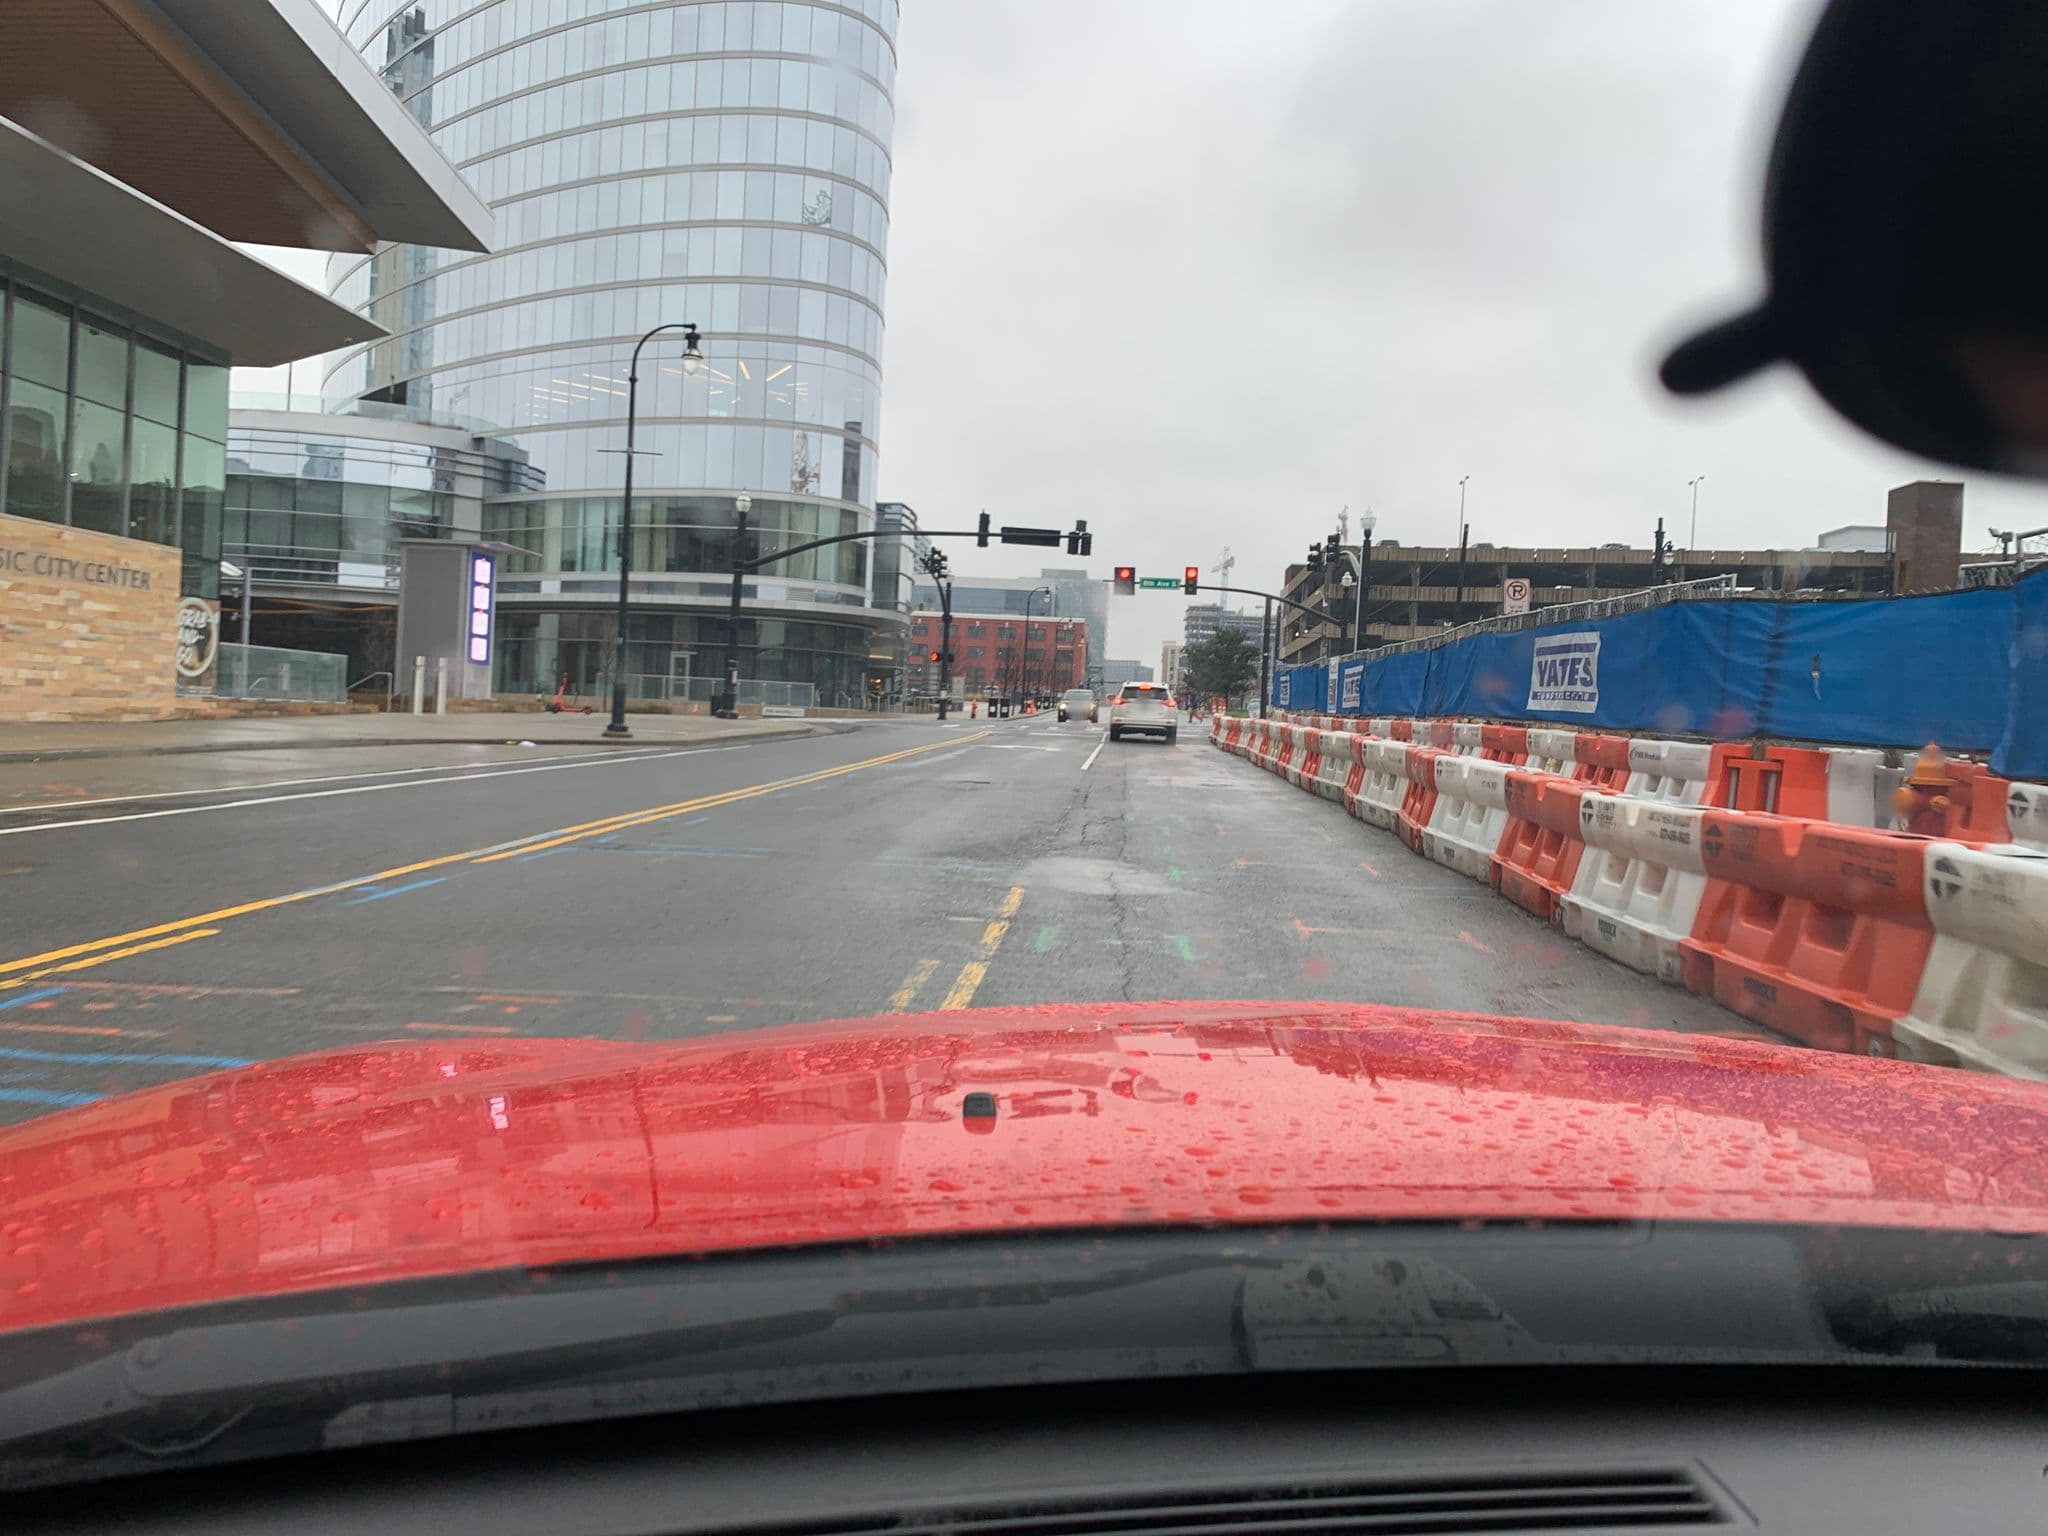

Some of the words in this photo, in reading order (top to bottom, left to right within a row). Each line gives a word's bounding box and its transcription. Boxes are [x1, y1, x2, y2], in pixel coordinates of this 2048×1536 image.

[33, 552, 80, 579] CITY
[83, 561, 151, 591] CENTER
[1537, 657, 1594, 688] YATES
